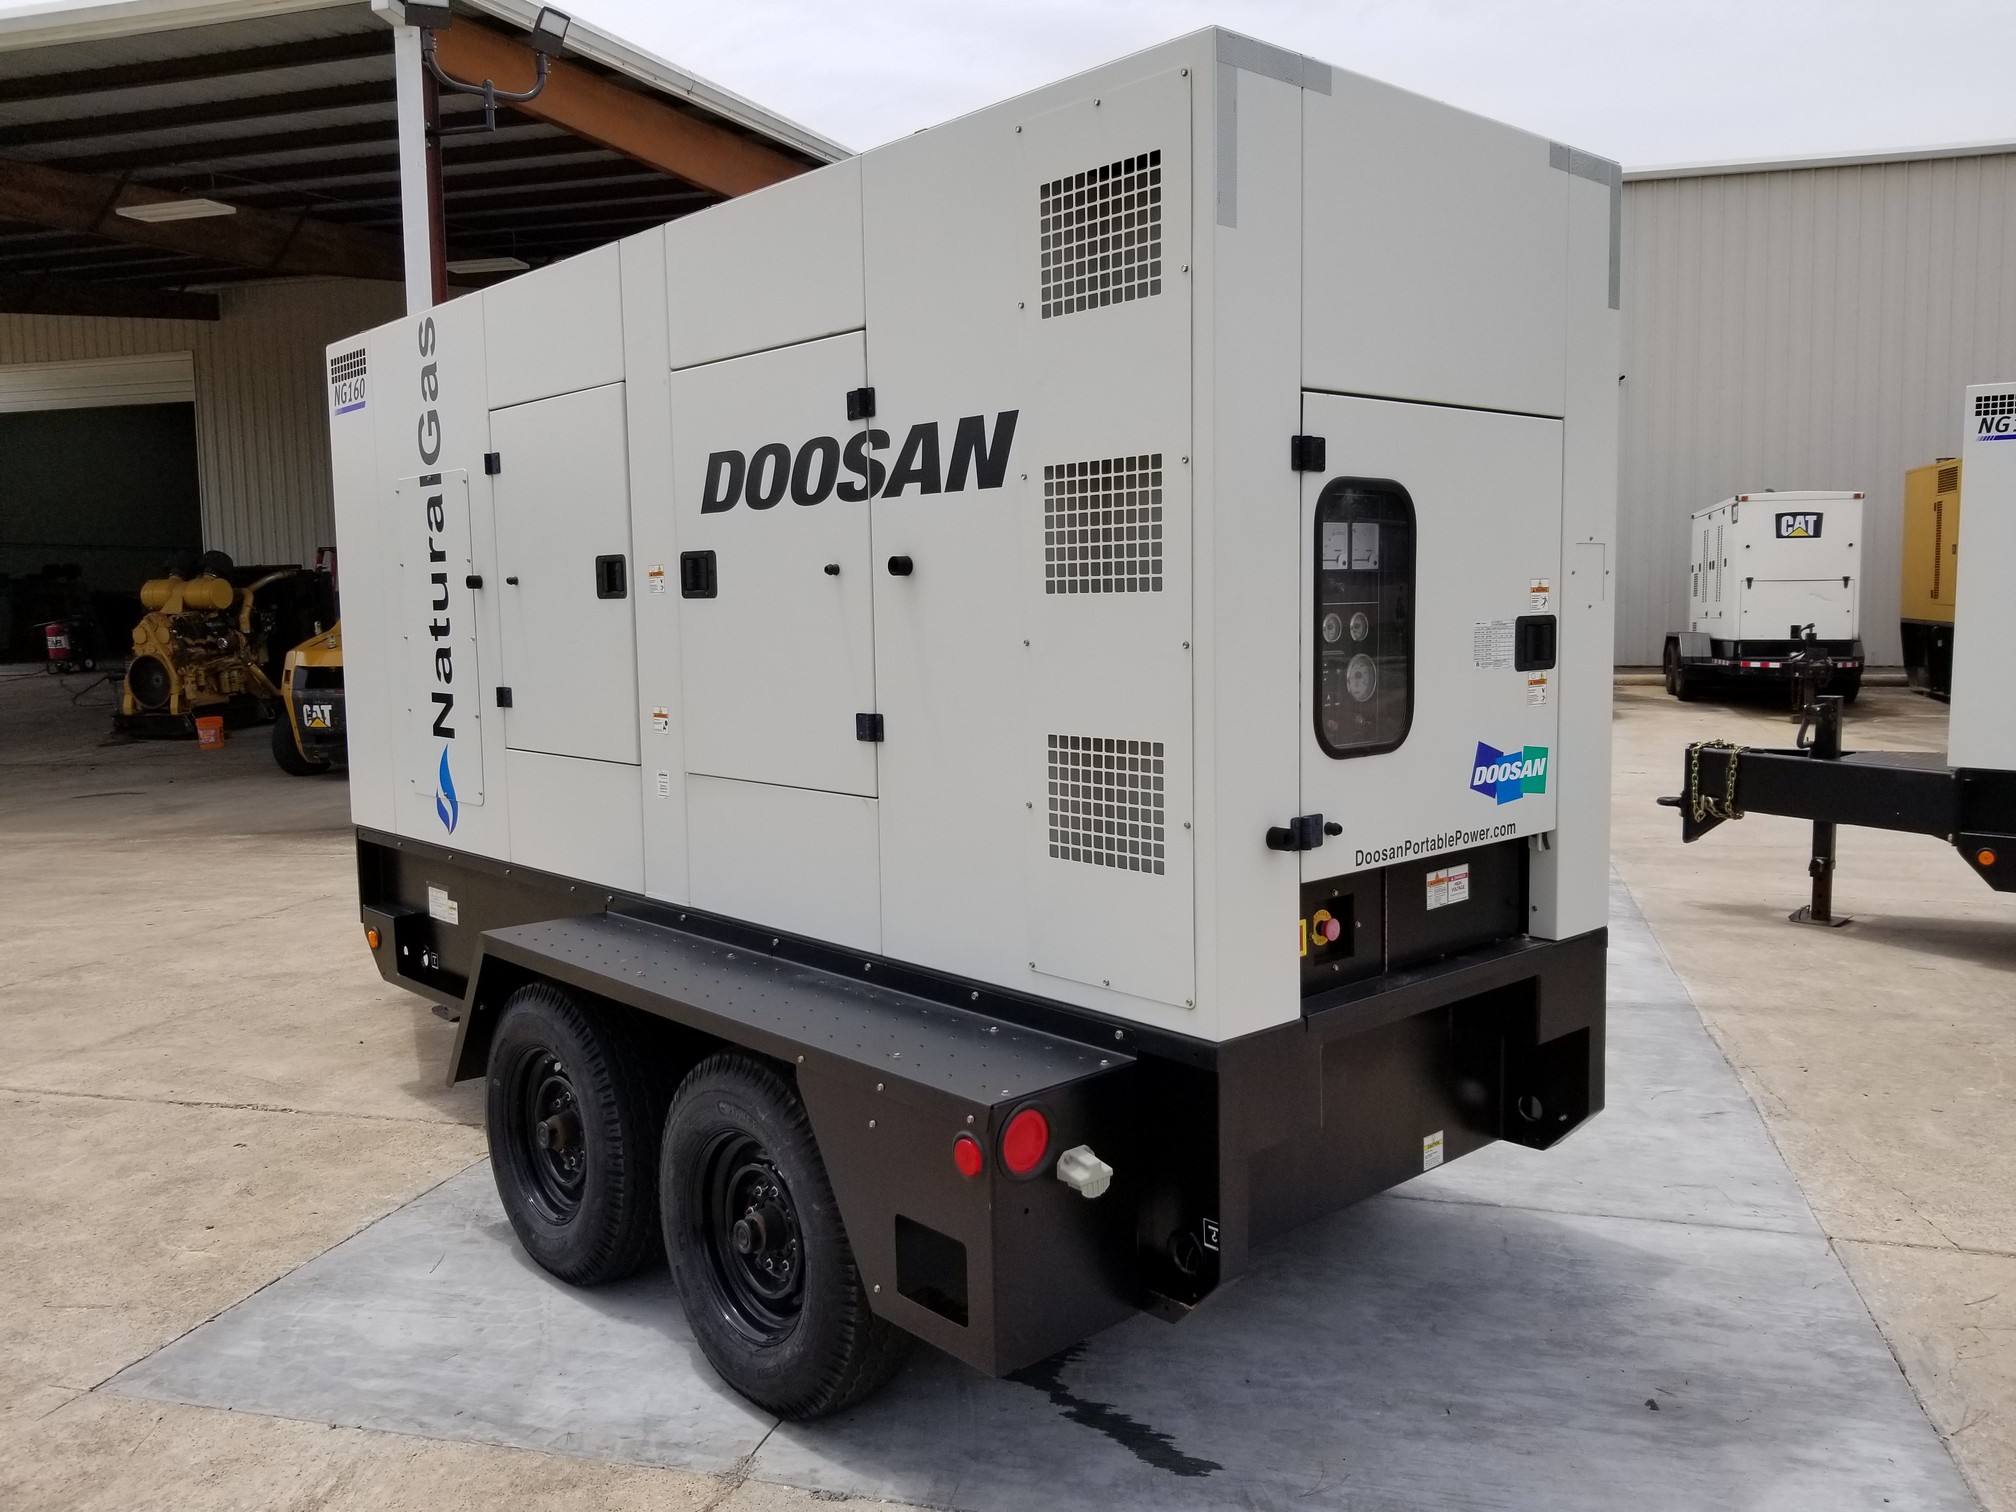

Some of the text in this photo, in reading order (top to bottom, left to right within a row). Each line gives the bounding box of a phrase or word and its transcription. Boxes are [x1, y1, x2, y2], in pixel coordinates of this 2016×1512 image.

[334, 378, 366, 407] NG160
[700, 409, 1019, 514] DOOSAN
[417, 316, 456, 739] Natural Gas
[1781, 515, 1817, 536] CAT
[303, 704, 332, 727] CAT
[1473, 758, 1546, 785] DOOSAN
[1355, 822, 1516, 866] DoosanPortablePower.com
